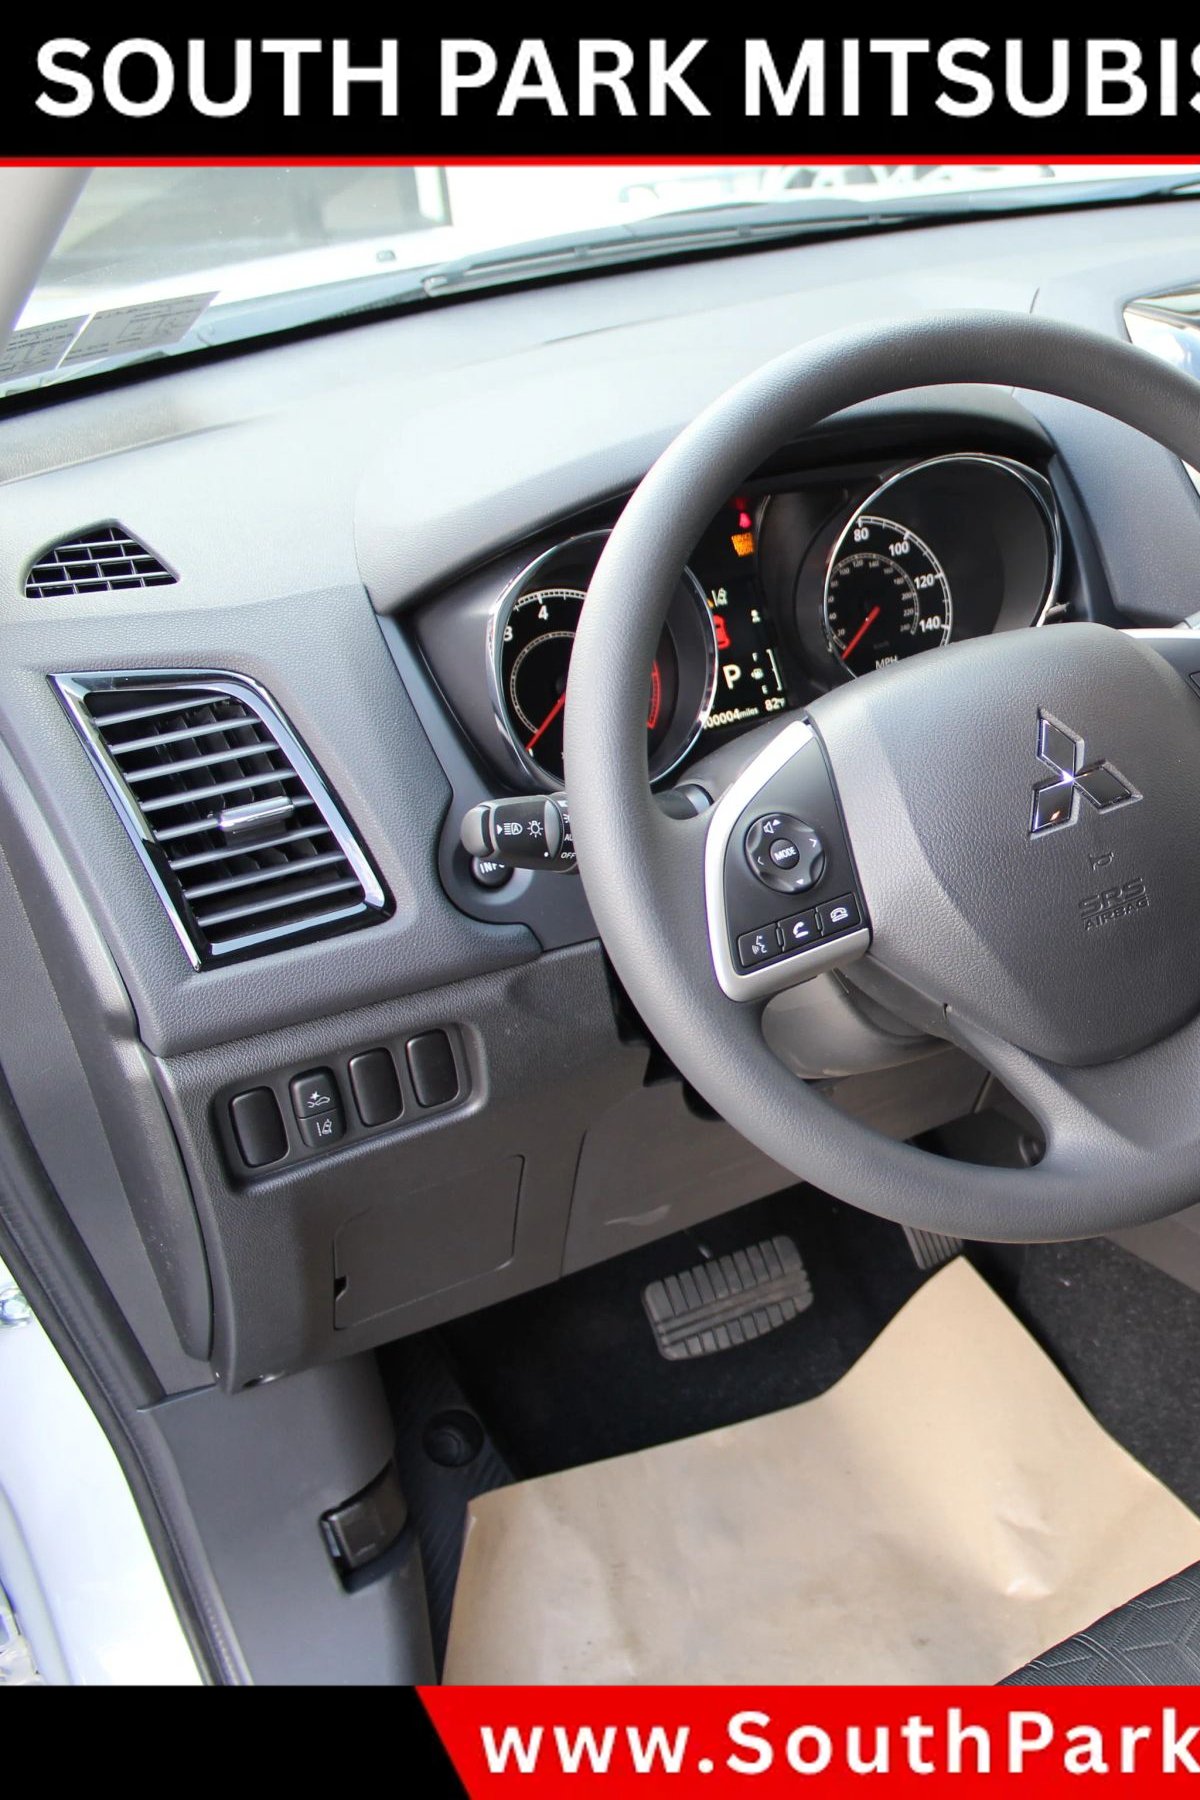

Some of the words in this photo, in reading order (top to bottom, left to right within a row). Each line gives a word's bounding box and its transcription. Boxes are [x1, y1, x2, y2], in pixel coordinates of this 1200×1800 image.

[853, 527, 869, 543] 80
[888, 540, 910, 557] 100
[914, 574, 934, 590] 120
[537, 604, 549, 621] 4
[919, 616, 941, 633] 140
[722, 664, 742, 690] P
[774, 846, 797, 861] MODE
[1078, 878, 1147, 919] SRS
[1084, 896, 1151, 931] AIRBAG
